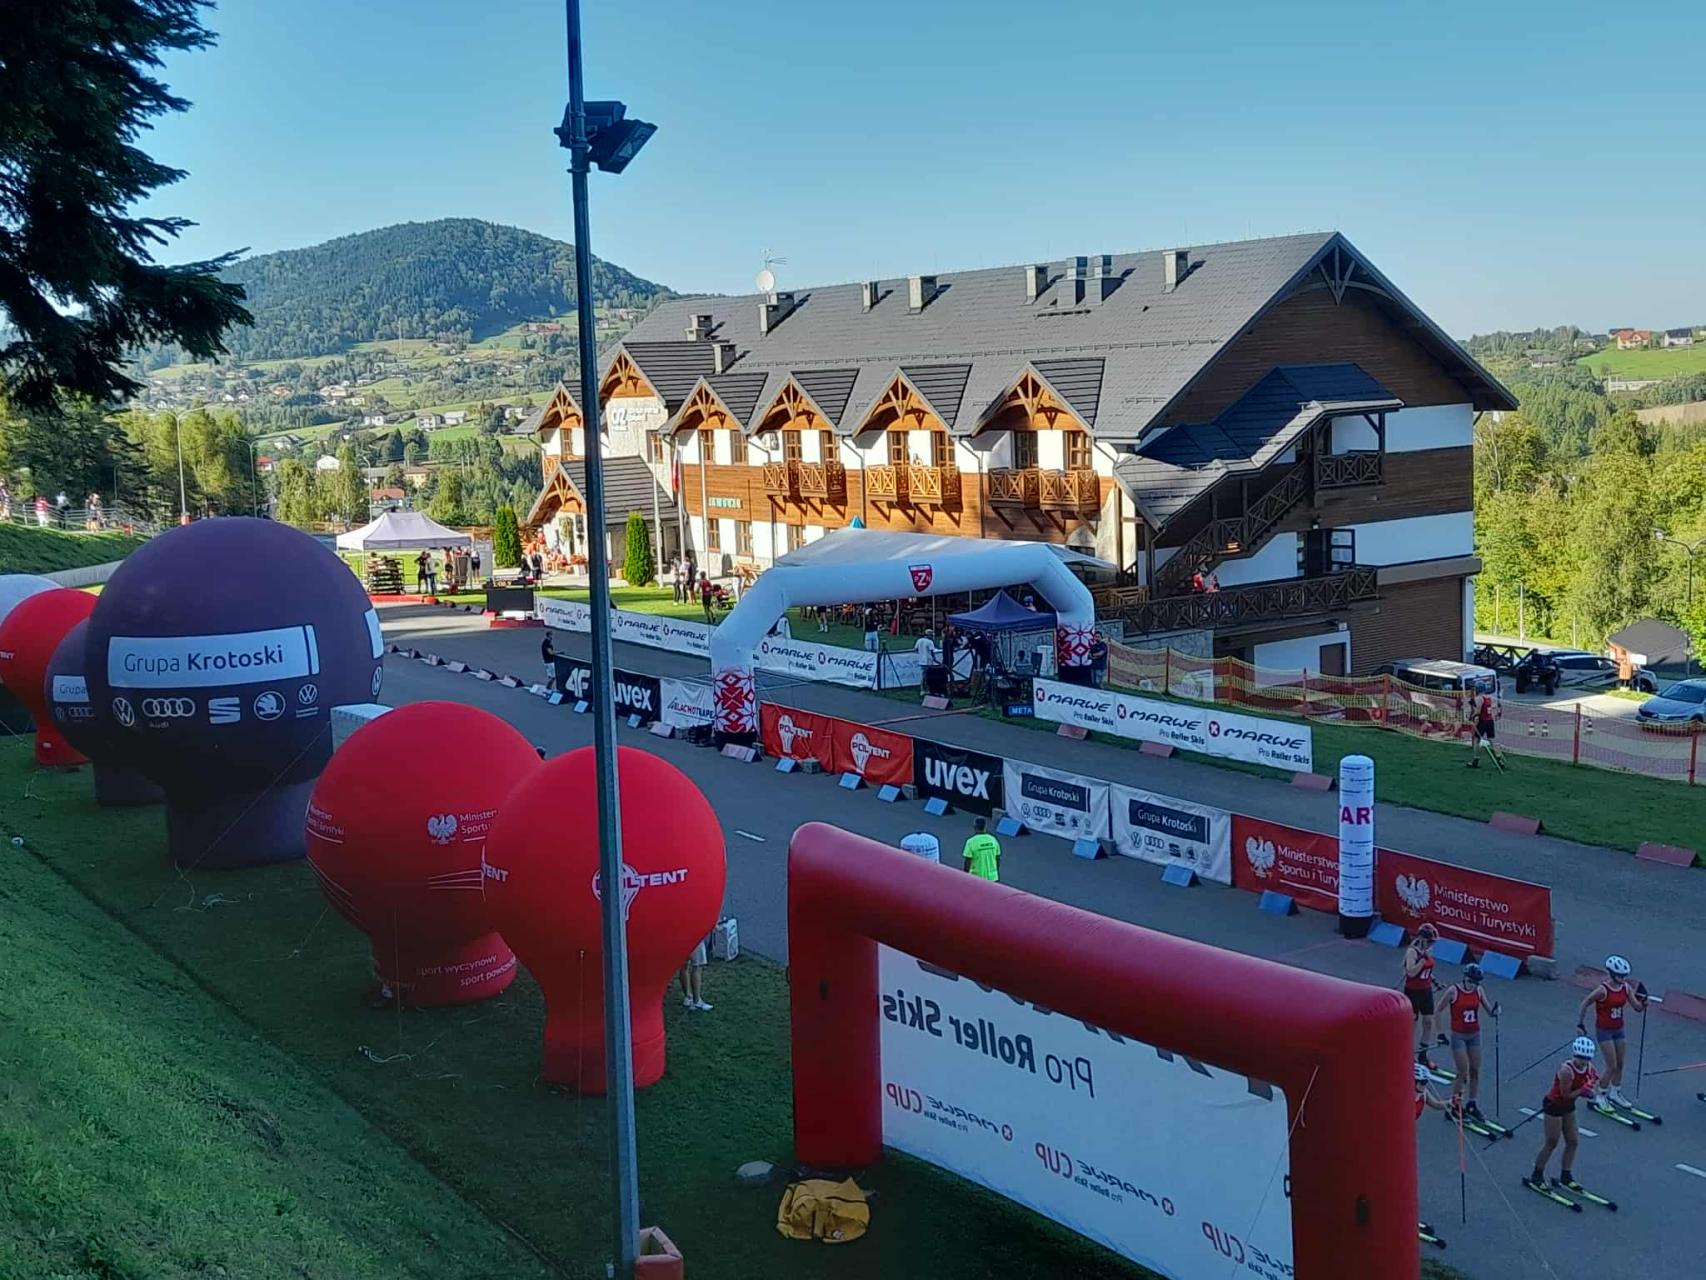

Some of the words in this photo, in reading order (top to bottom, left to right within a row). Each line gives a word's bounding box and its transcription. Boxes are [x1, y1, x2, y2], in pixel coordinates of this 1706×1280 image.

[124, 653, 181, 676] Grupa
[187, 644, 284, 671] Krotoski
[770, 645, 815, 662] MARWE
[827, 656, 875, 672] MARWE
[565, 667, 592, 699] 4F
[1047, 693, 1112, 714] MARWE
[1129, 711, 1203, 731] MARWE
[1223, 728, 1307, 750] MARWE
[852, 742, 892, 759] POLTENT
[924, 756, 991, 801] uvex
[1049, 786, 1081, 803] Krotoski
[1162, 815, 1198, 833] Krotoski
[1340, 806, 1374, 824] AR
[1433, 882, 1510, 914] Ministerstwo
[1433, 900, 1471, 921] Sportu
[1480, 912, 1536, 937] Turystyki
